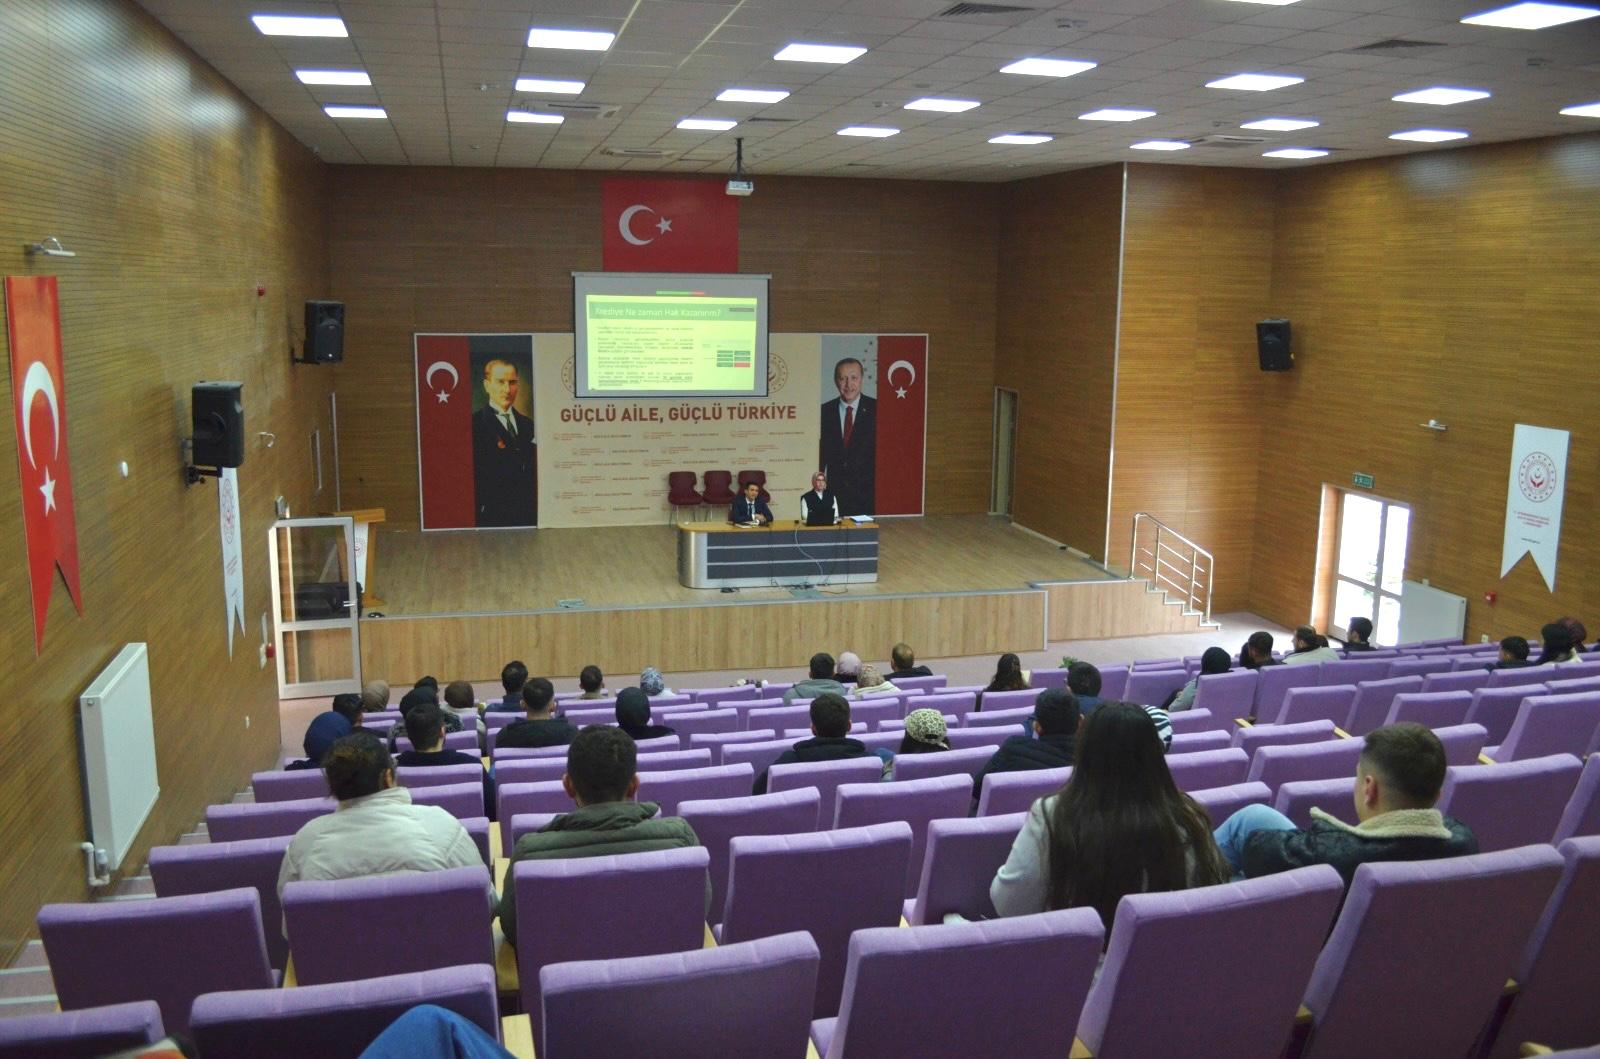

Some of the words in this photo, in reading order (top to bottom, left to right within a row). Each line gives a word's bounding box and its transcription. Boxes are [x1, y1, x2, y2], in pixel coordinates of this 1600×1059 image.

[560, 404, 616, 426] GÜÇLÜ
[620, 403, 664, 424] AİLE,
[668, 402, 723, 425] GÜÇLÜ
[726, 401, 797, 421] TÜRKİYE
